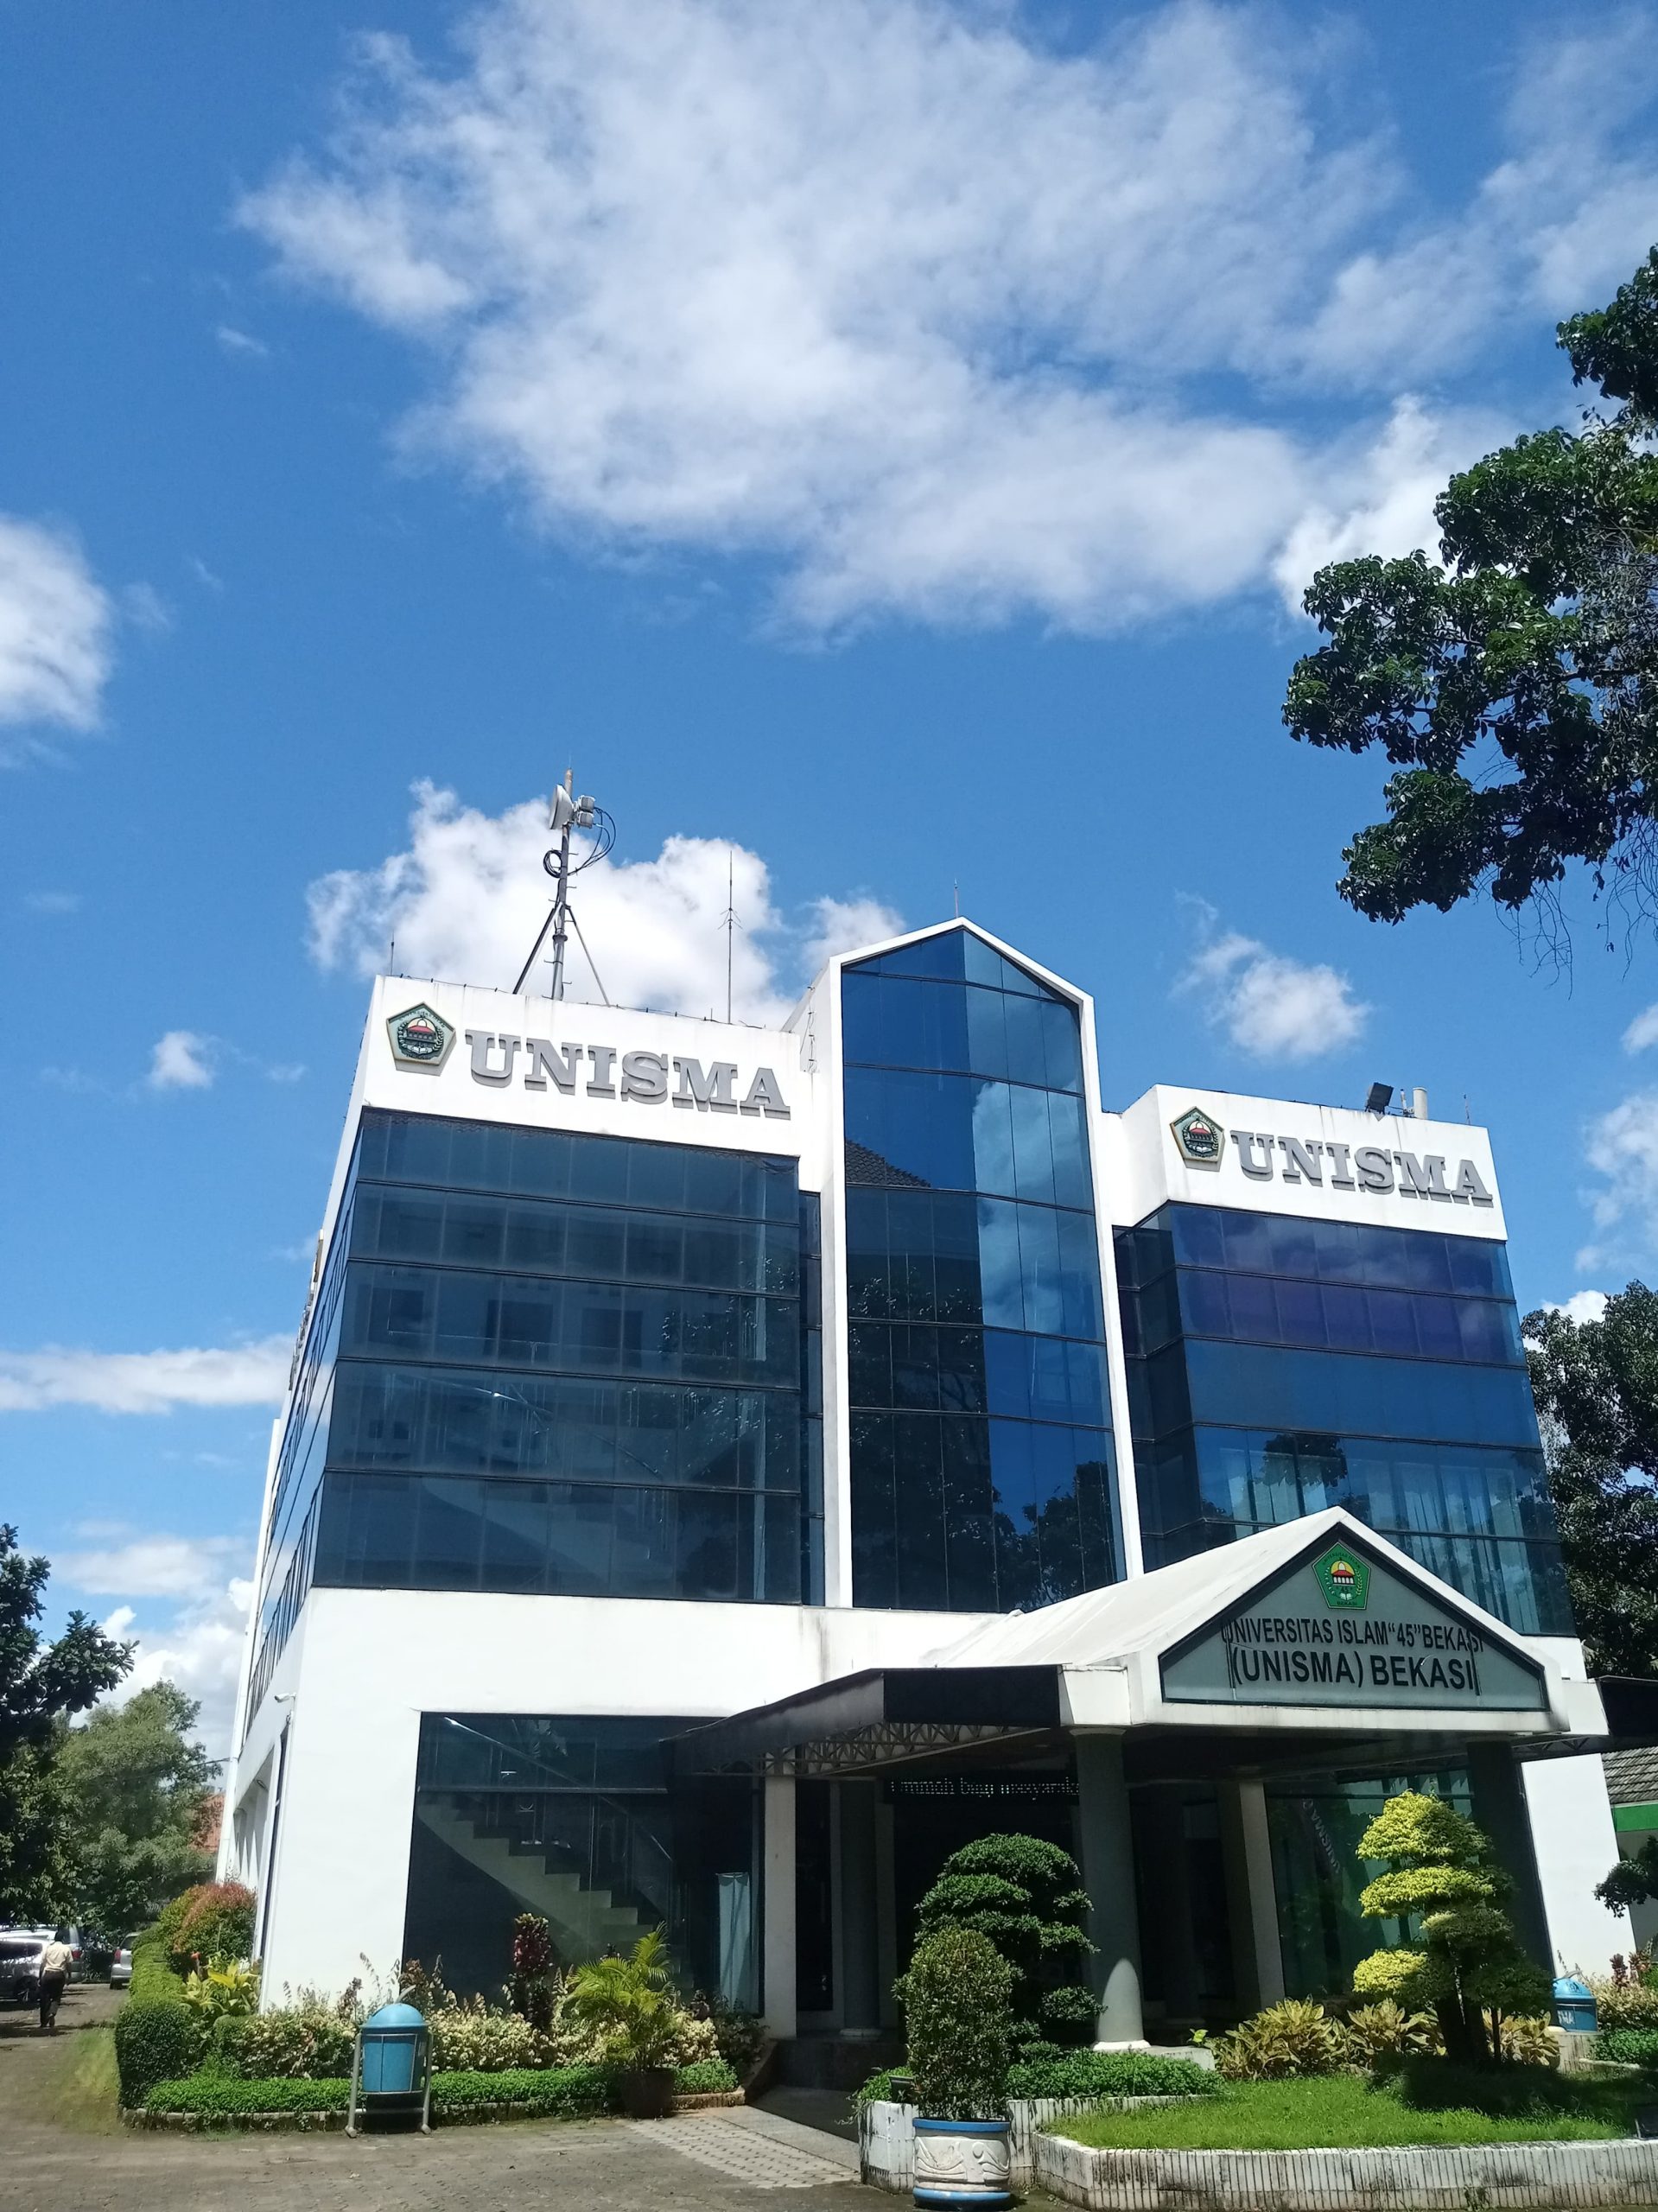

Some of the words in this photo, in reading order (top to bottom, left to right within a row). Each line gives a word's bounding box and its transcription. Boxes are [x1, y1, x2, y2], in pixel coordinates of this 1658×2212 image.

[465, 1029, 791, 1121] UNISMA
[1230, 1129, 1494, 1208] UNISMA
[1221, 1618, 1334, 1644] UNIVERSITAS
[1232, 1646, 1363, 1688] (UNISMA)
[1369, 1654, 1474, 1690] BEKASI
